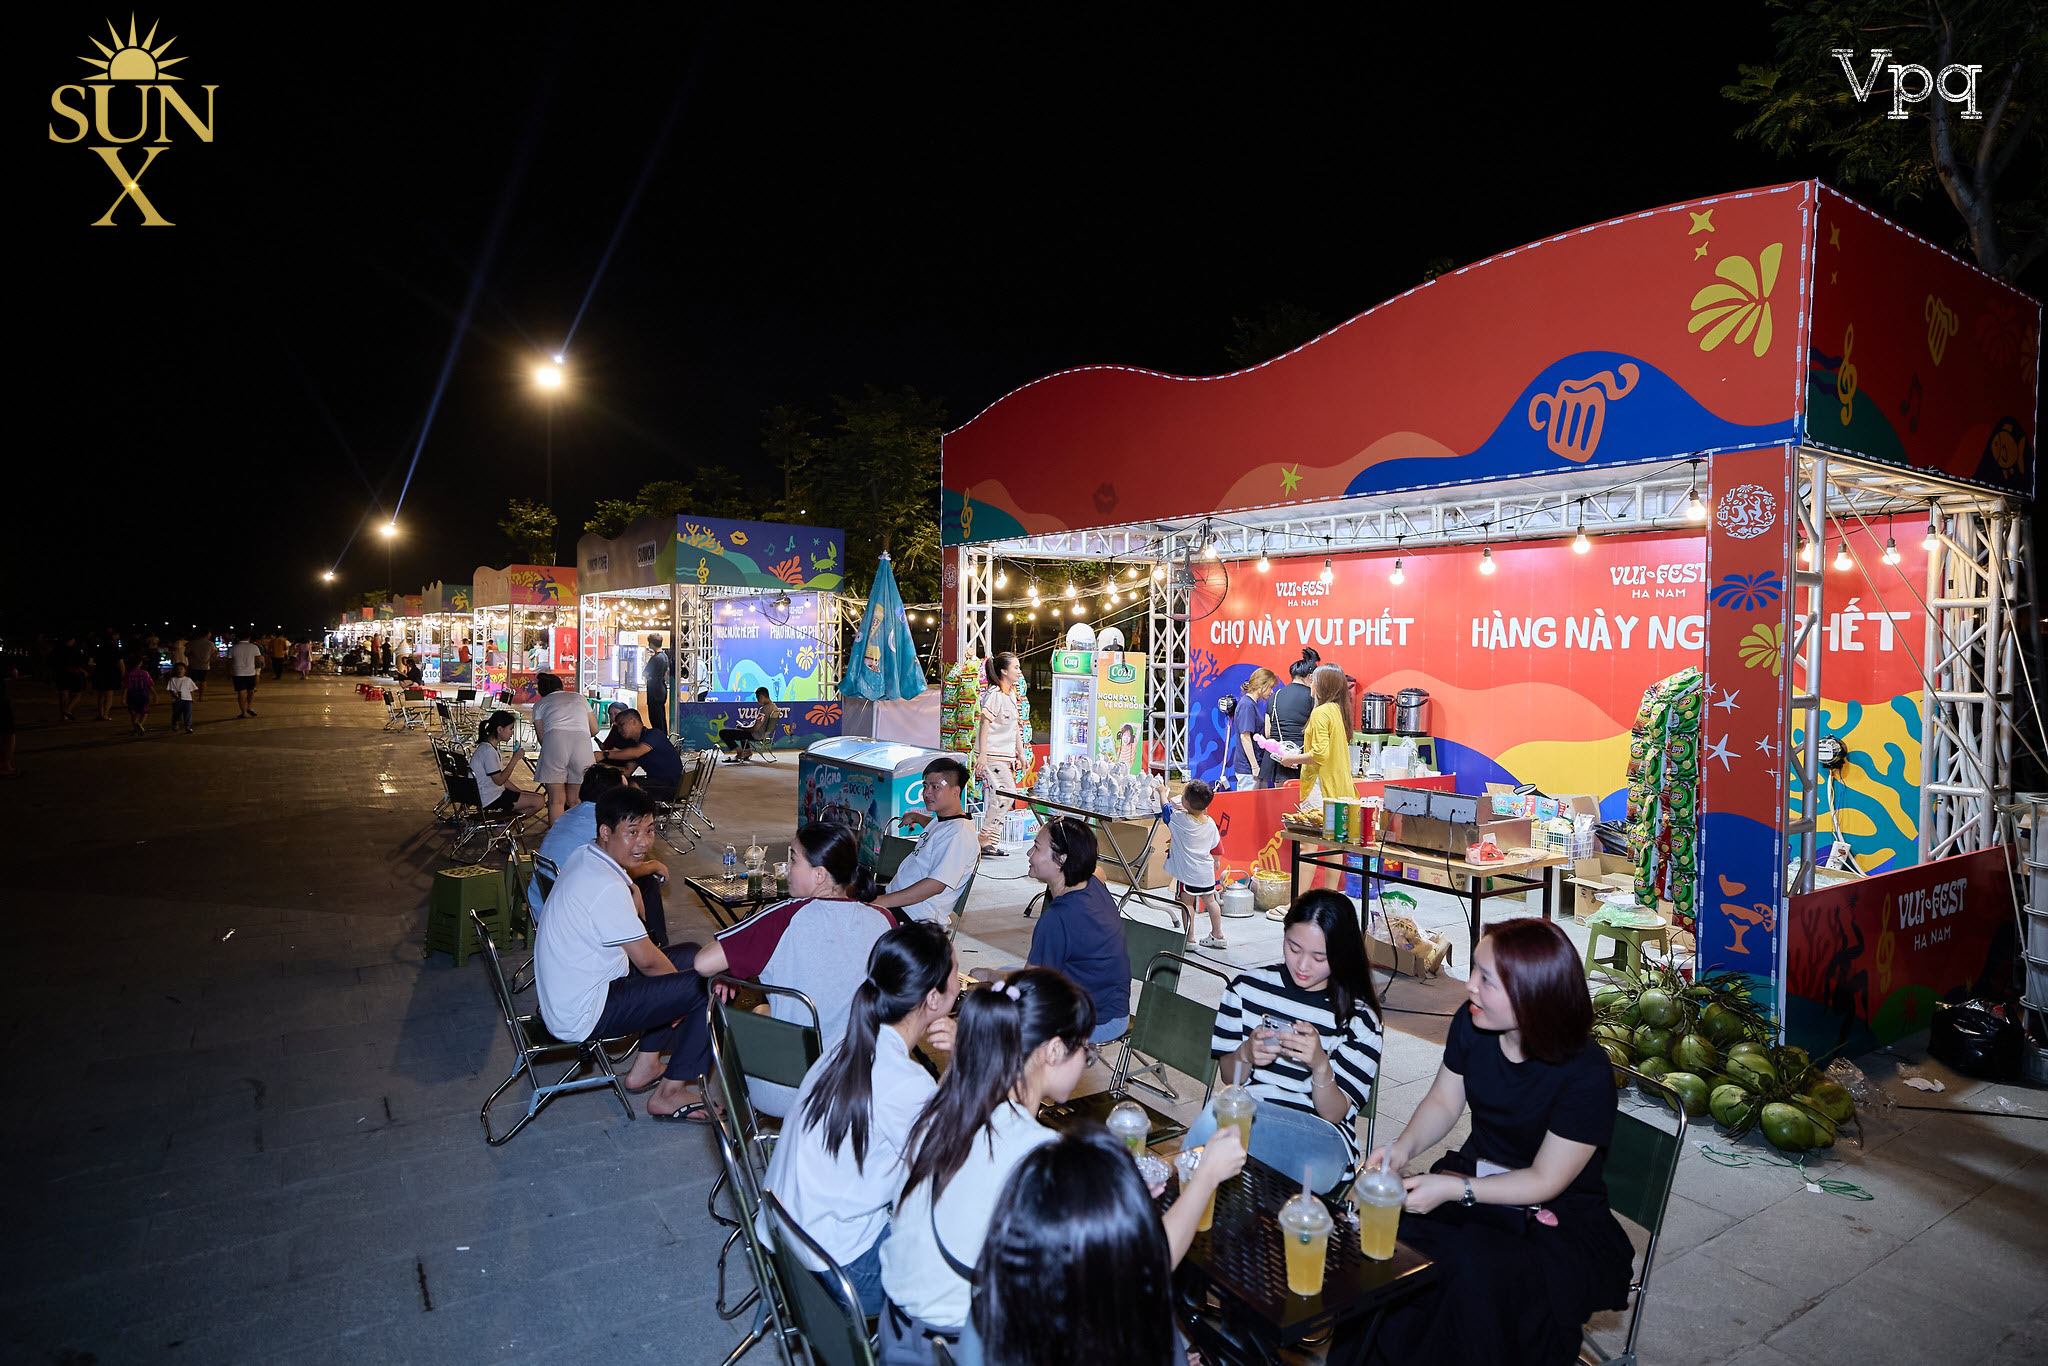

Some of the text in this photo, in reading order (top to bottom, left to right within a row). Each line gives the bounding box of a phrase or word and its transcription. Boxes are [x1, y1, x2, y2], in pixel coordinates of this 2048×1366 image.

[1287, 599, 1319, 607] HA NAM
[1631, 588, 1686, 599] HA NAM
[1210, 607, 1415, 649] CHỢ NÀY VUI PHẾT
[1471, 609, 1557, 651] HÀNG
[1564, 607, 1640, 652] NÀY
[1649, 614, 1706, 651] NG
[1914, 925, 1951, 951] HA NAM
